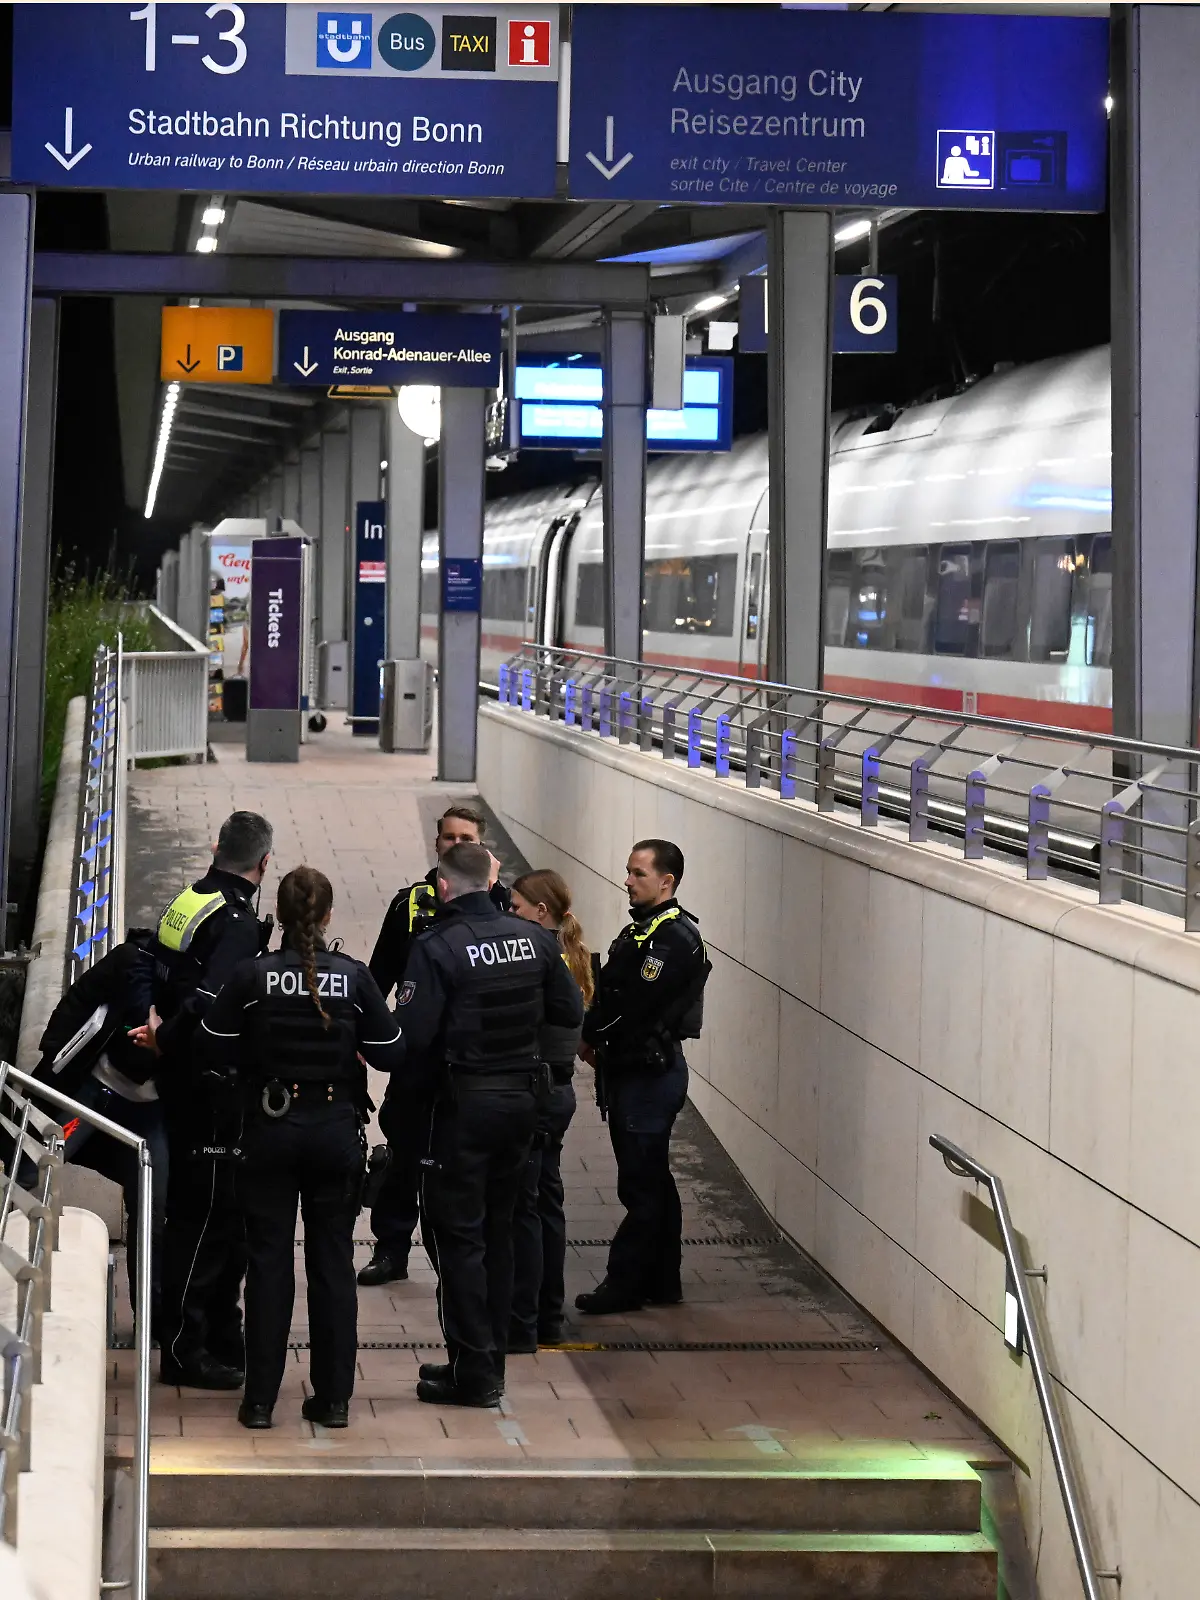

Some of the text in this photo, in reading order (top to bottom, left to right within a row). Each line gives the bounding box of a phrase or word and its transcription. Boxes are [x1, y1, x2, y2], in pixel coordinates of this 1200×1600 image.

[130, 3, 247, 75] 1-3
[318, 32, 371, 41] stadtbahn
[390, 33, 425, 51] Bus
[450, 35, 489, 53] TAXI
[672, 67, 863, 103] Ausgang City
[128, 108, 483, 147] Stadtbahn Richtung Bonn
[671, 108, 865, 138] Reisezentrum
[128, 152, 171, 166] Urban
[174, 154, 226, 171] railway
[229, 156, 243, 169] to
[247, 155, 284, 169] Bonn
[298, 157, 350, 172] Réseau
[353, 158, 399, 172] urbain
[402, 160, 464, 174] direction
[467, 161, 505, 175] Bonn
[670, 157, 698, 170] exit
[703, 158, 730, 174] city
[747, 157, 791, 173] Travel
[796, 158, 848, 173] Center
[670, 178, 714, 192] sortie
[764, 179, 816, 194] Centre
[820, 181, 839, 195] de
[844, 184, 898, 198] voyage
[850, 278, 888, 335] 6
[334, 328, 395, 345] Ausgang
[219, 347, 235, 370] P
[333, 347, 492, 363] Konrad-Adenauer-Allee
[350, 366, 373, 375] Sortie
[268, 588, 283, 649] Tickets
[162, 907, 189, 932] POLIZEI
[466, 938, 537, 968] POLIZEI
[266, 971, 348, 998] POLZEI
